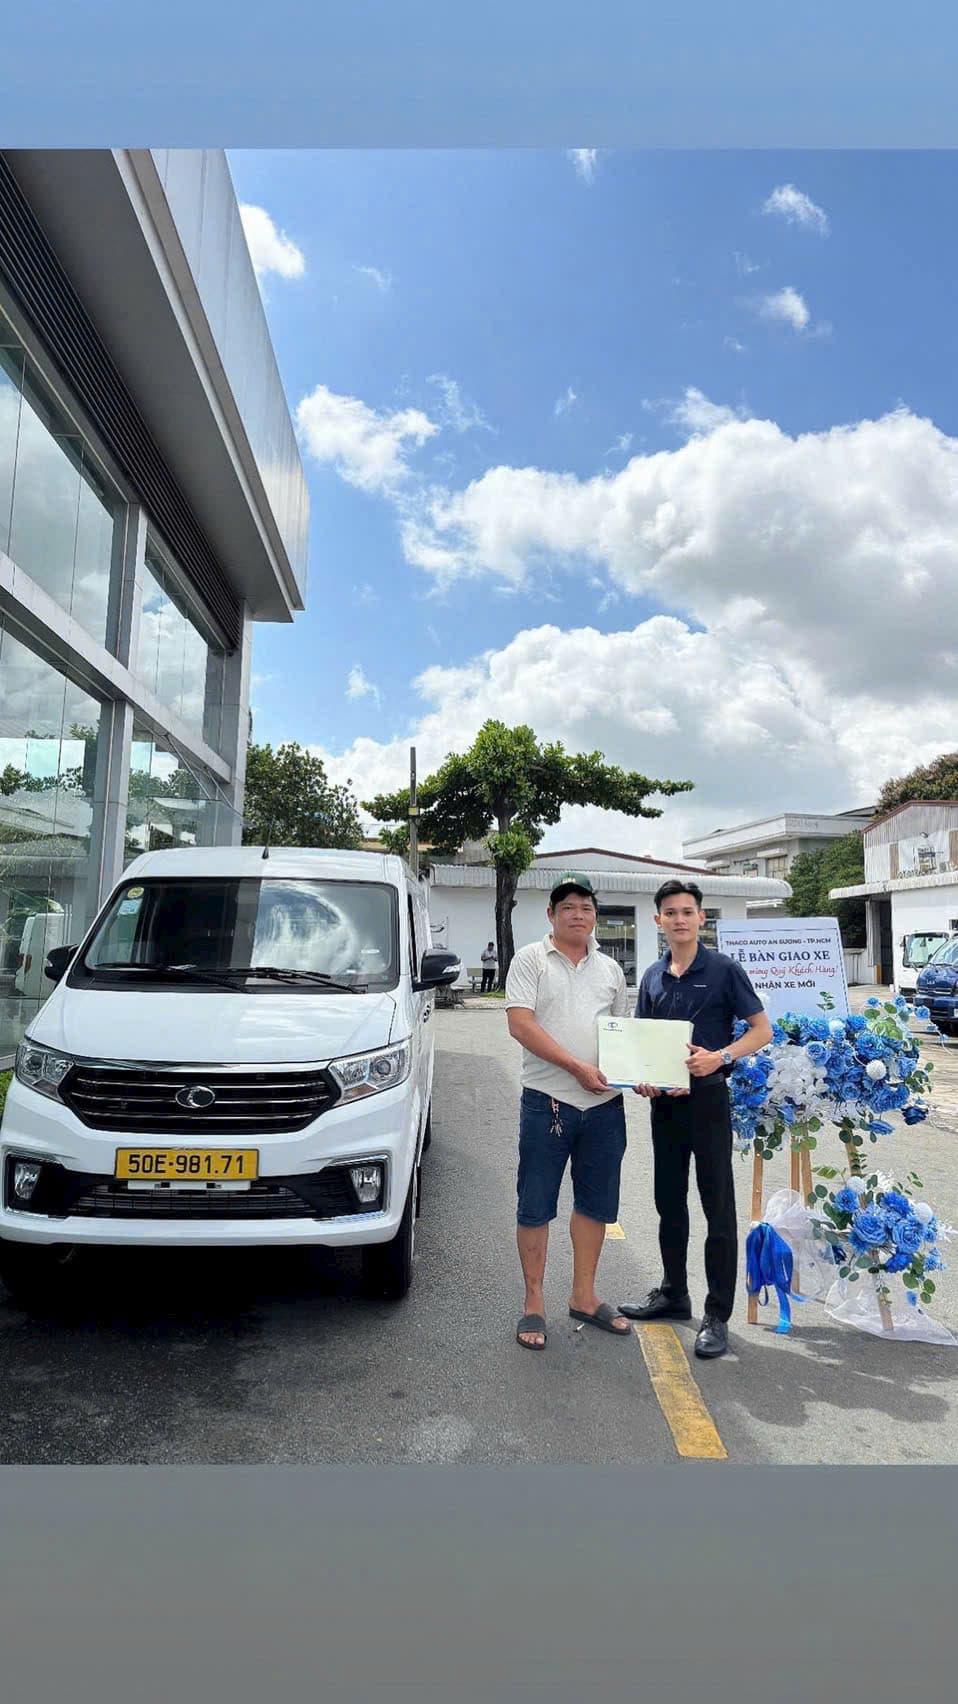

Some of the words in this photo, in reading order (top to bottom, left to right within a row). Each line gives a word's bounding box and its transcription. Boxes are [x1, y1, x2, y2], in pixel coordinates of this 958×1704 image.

[749, 949, 775, 962] BÀN
[778, 951, 810, 961] GIAO
[813, 950, 830, 961] XE
[754, 980, 781, 991] NHẬN
[783, 981, 796, 989] XE
[128, 1154, 244, 1174] 50E-981.71
